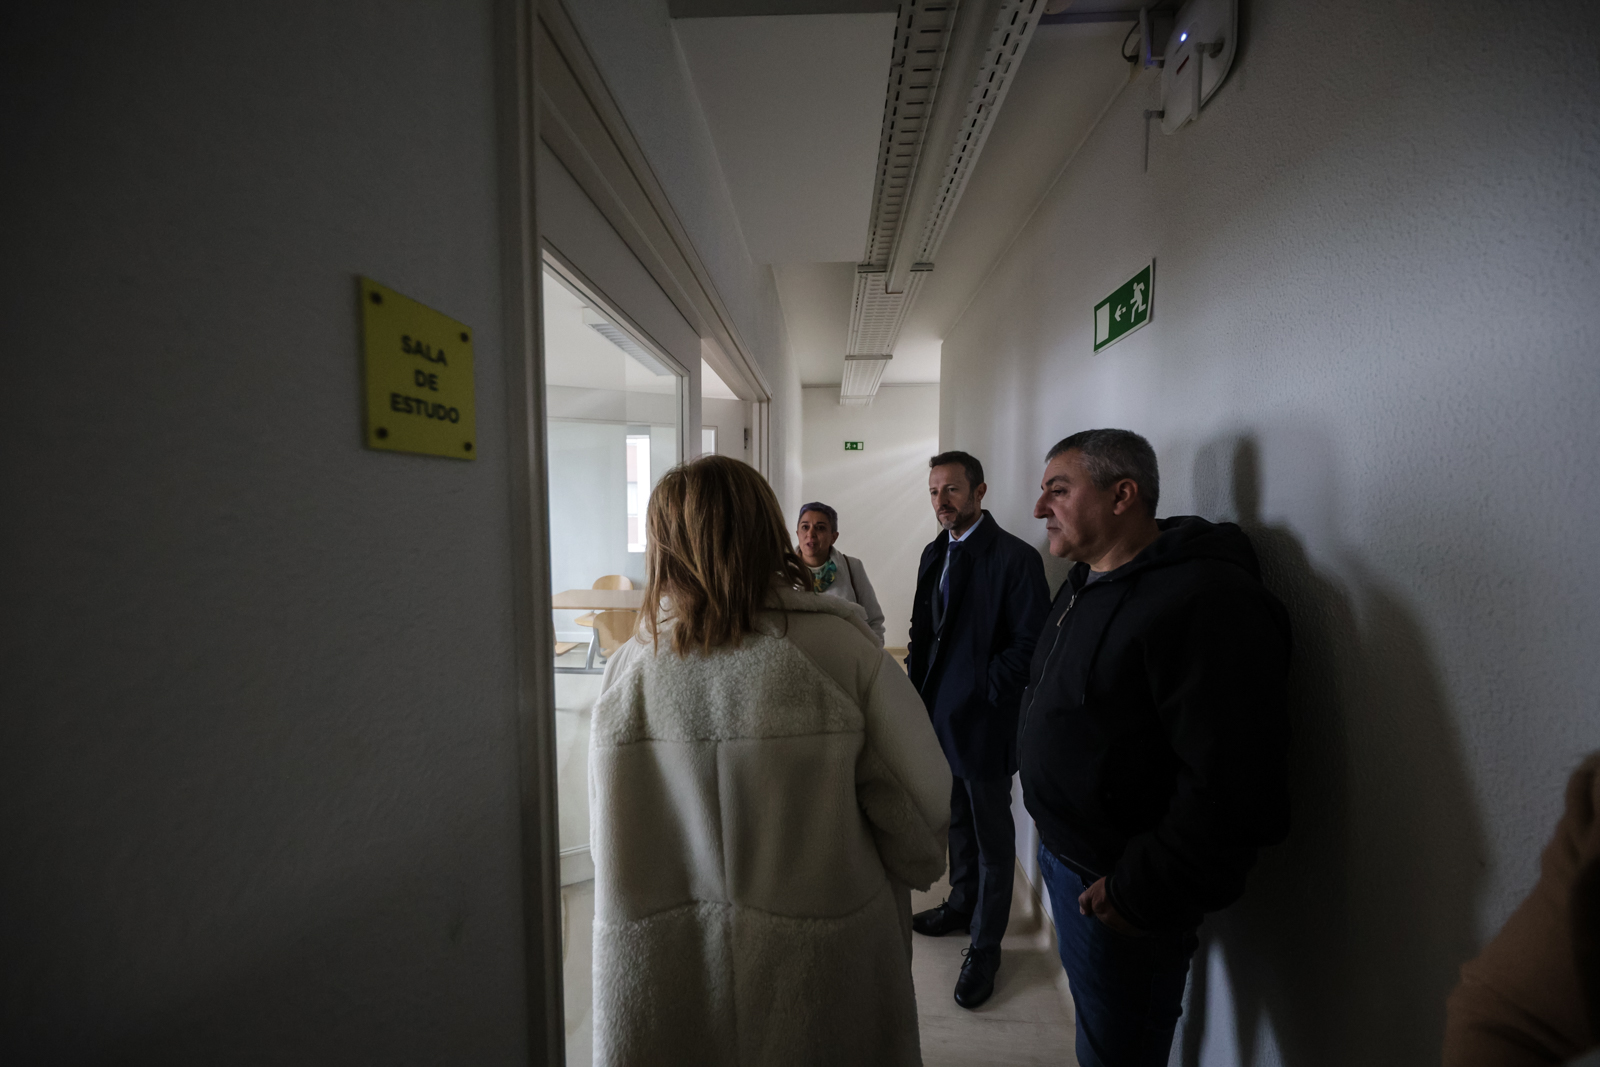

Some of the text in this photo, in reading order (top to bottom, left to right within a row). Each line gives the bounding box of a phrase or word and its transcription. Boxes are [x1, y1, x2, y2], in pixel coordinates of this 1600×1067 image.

[401, 335, 447, 366] SALA
[414, 370, 438, 391] DE
[390, 393, 460, 424] ESTUDO
